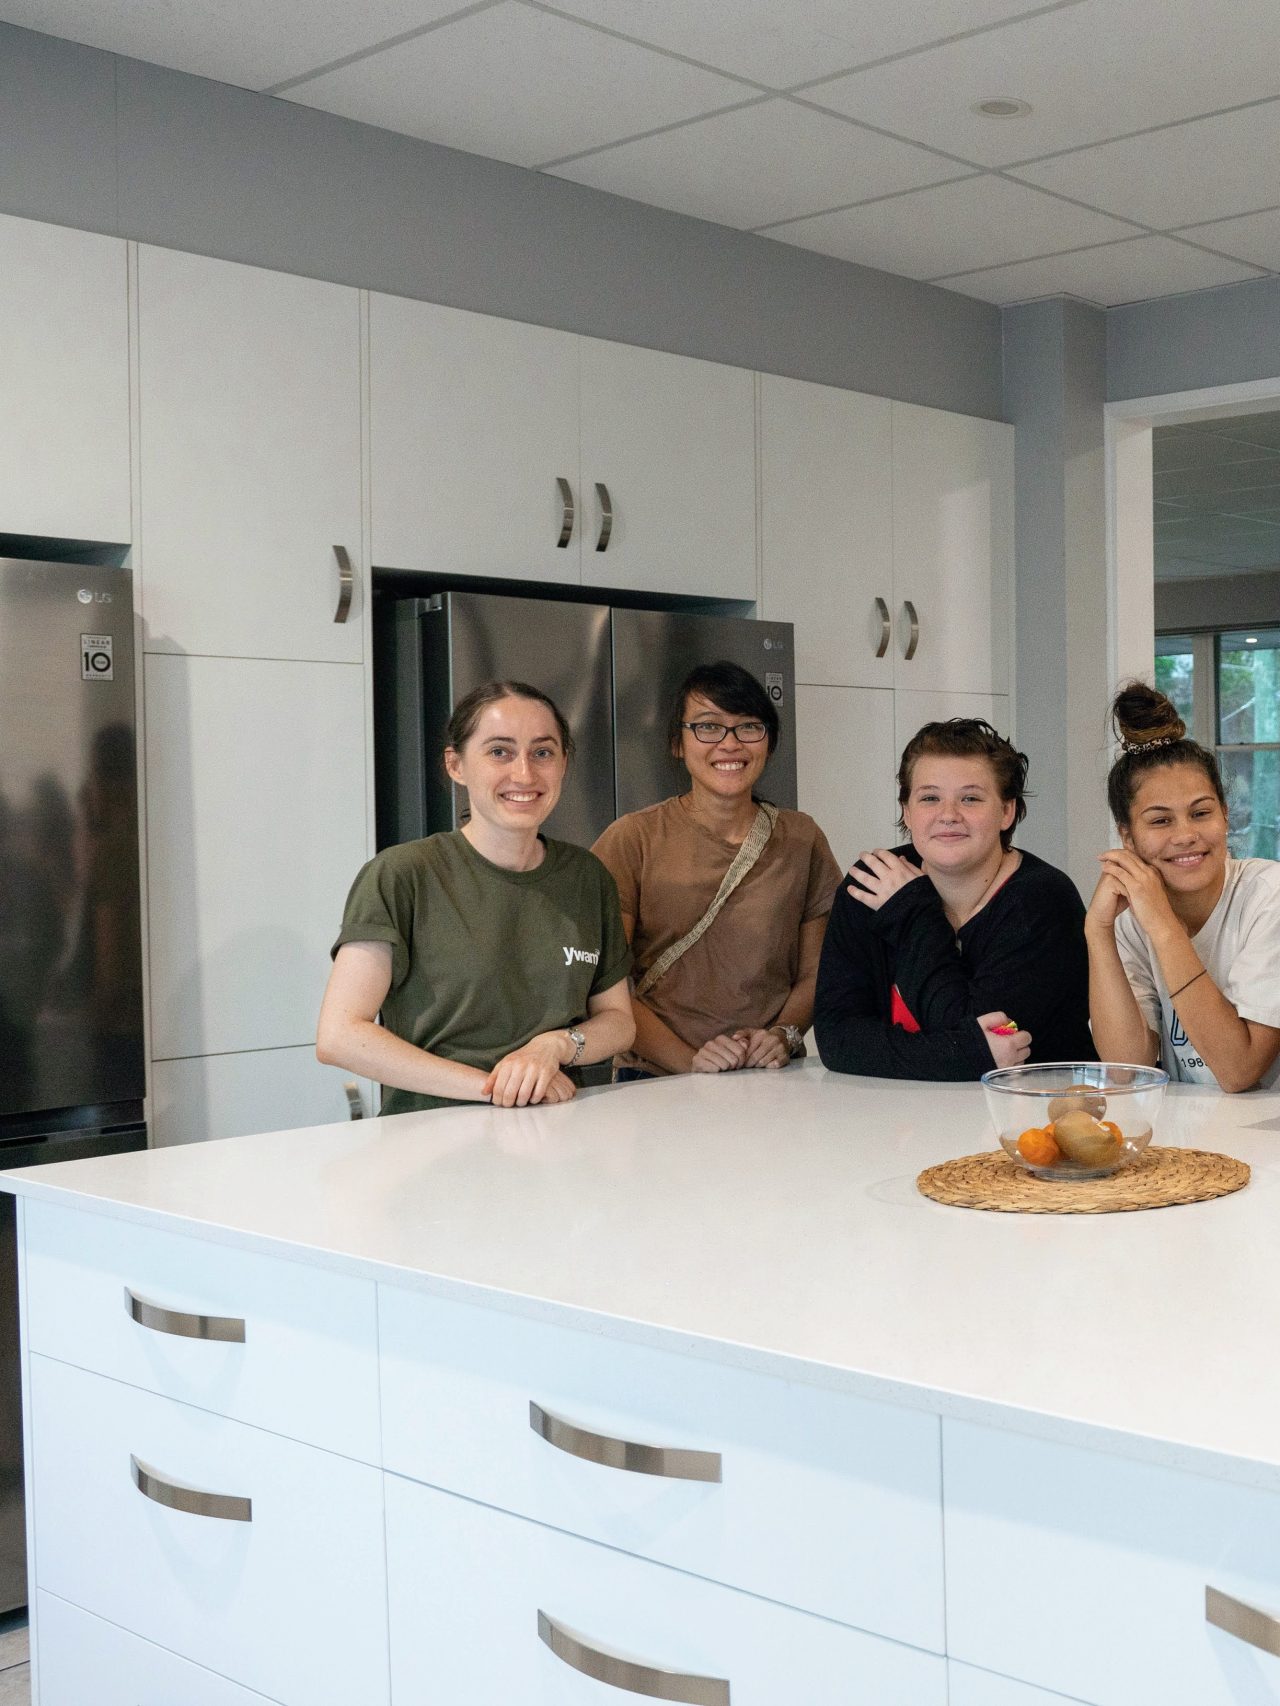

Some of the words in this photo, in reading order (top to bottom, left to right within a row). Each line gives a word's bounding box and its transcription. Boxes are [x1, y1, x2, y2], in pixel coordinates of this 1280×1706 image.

[94, 592, 112, 603] LG
[84, 652, 111, 672] 10
[563, 946, 599, 966] ywam
[1181, 1057, 1208, 1068] 198
